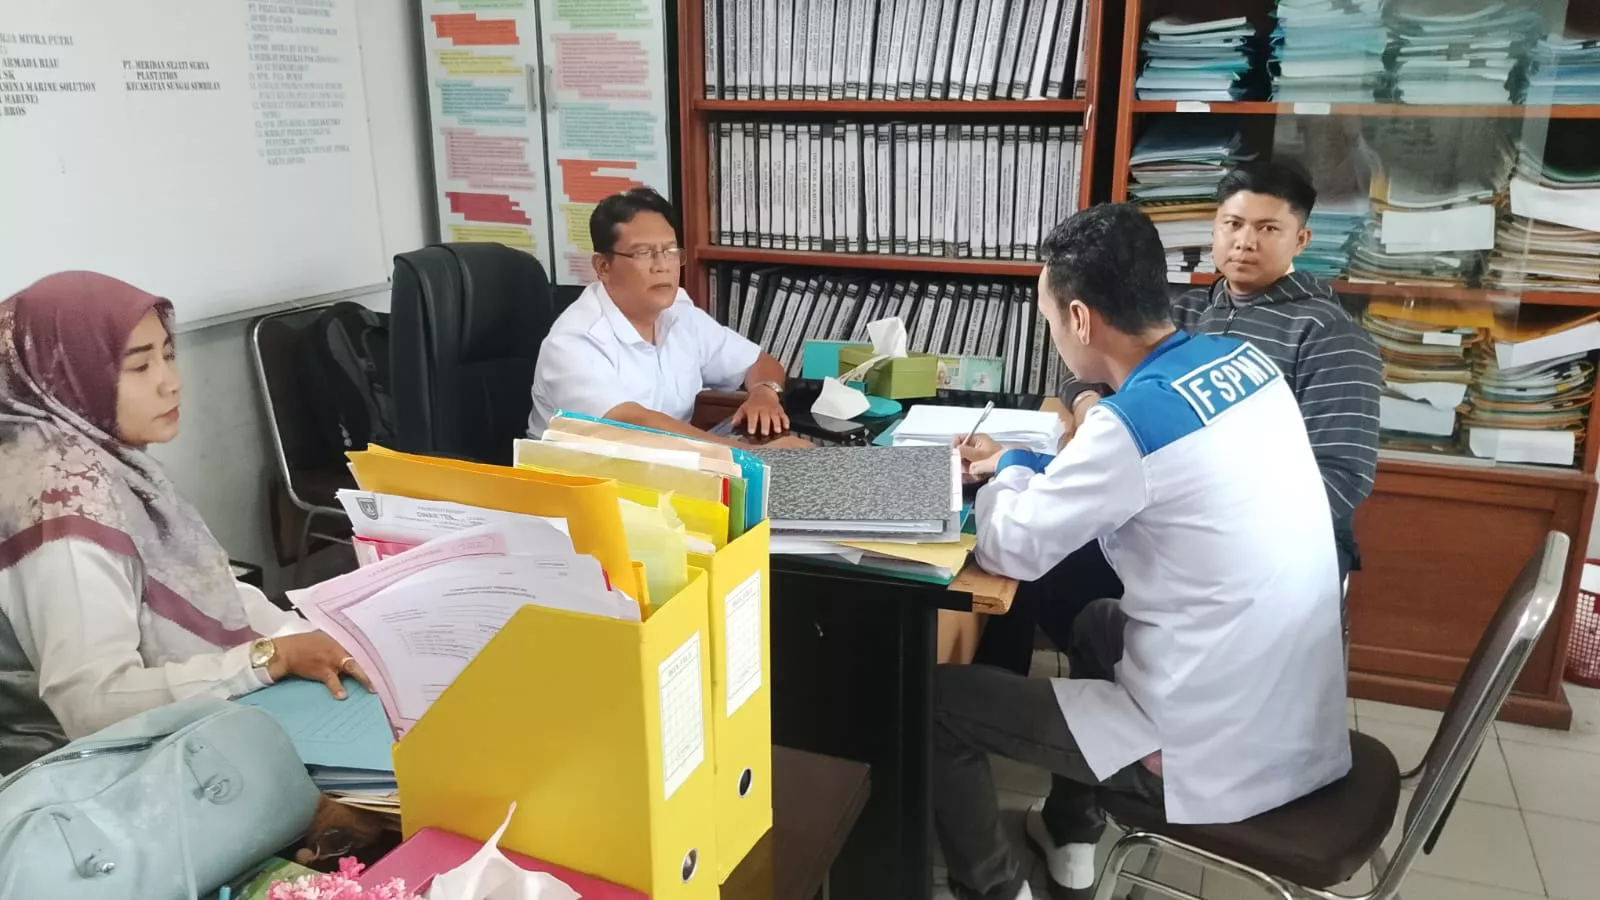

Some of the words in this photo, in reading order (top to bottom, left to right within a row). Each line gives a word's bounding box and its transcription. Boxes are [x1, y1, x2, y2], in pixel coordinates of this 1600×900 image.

[18, 34, 47, 45] MITRA
[48, 35, 74, 46] PUTRI
[2, 57, 38, 68] ARMADA
[39, 58, 60, 69] RIAU
[136, 71, 178, 80] PLANTATION
[26, 82, 57, 92] MARINE
[59, 82, 96, 92] SOLUTION
[126, 81, 166, 91] KECAMATAN
